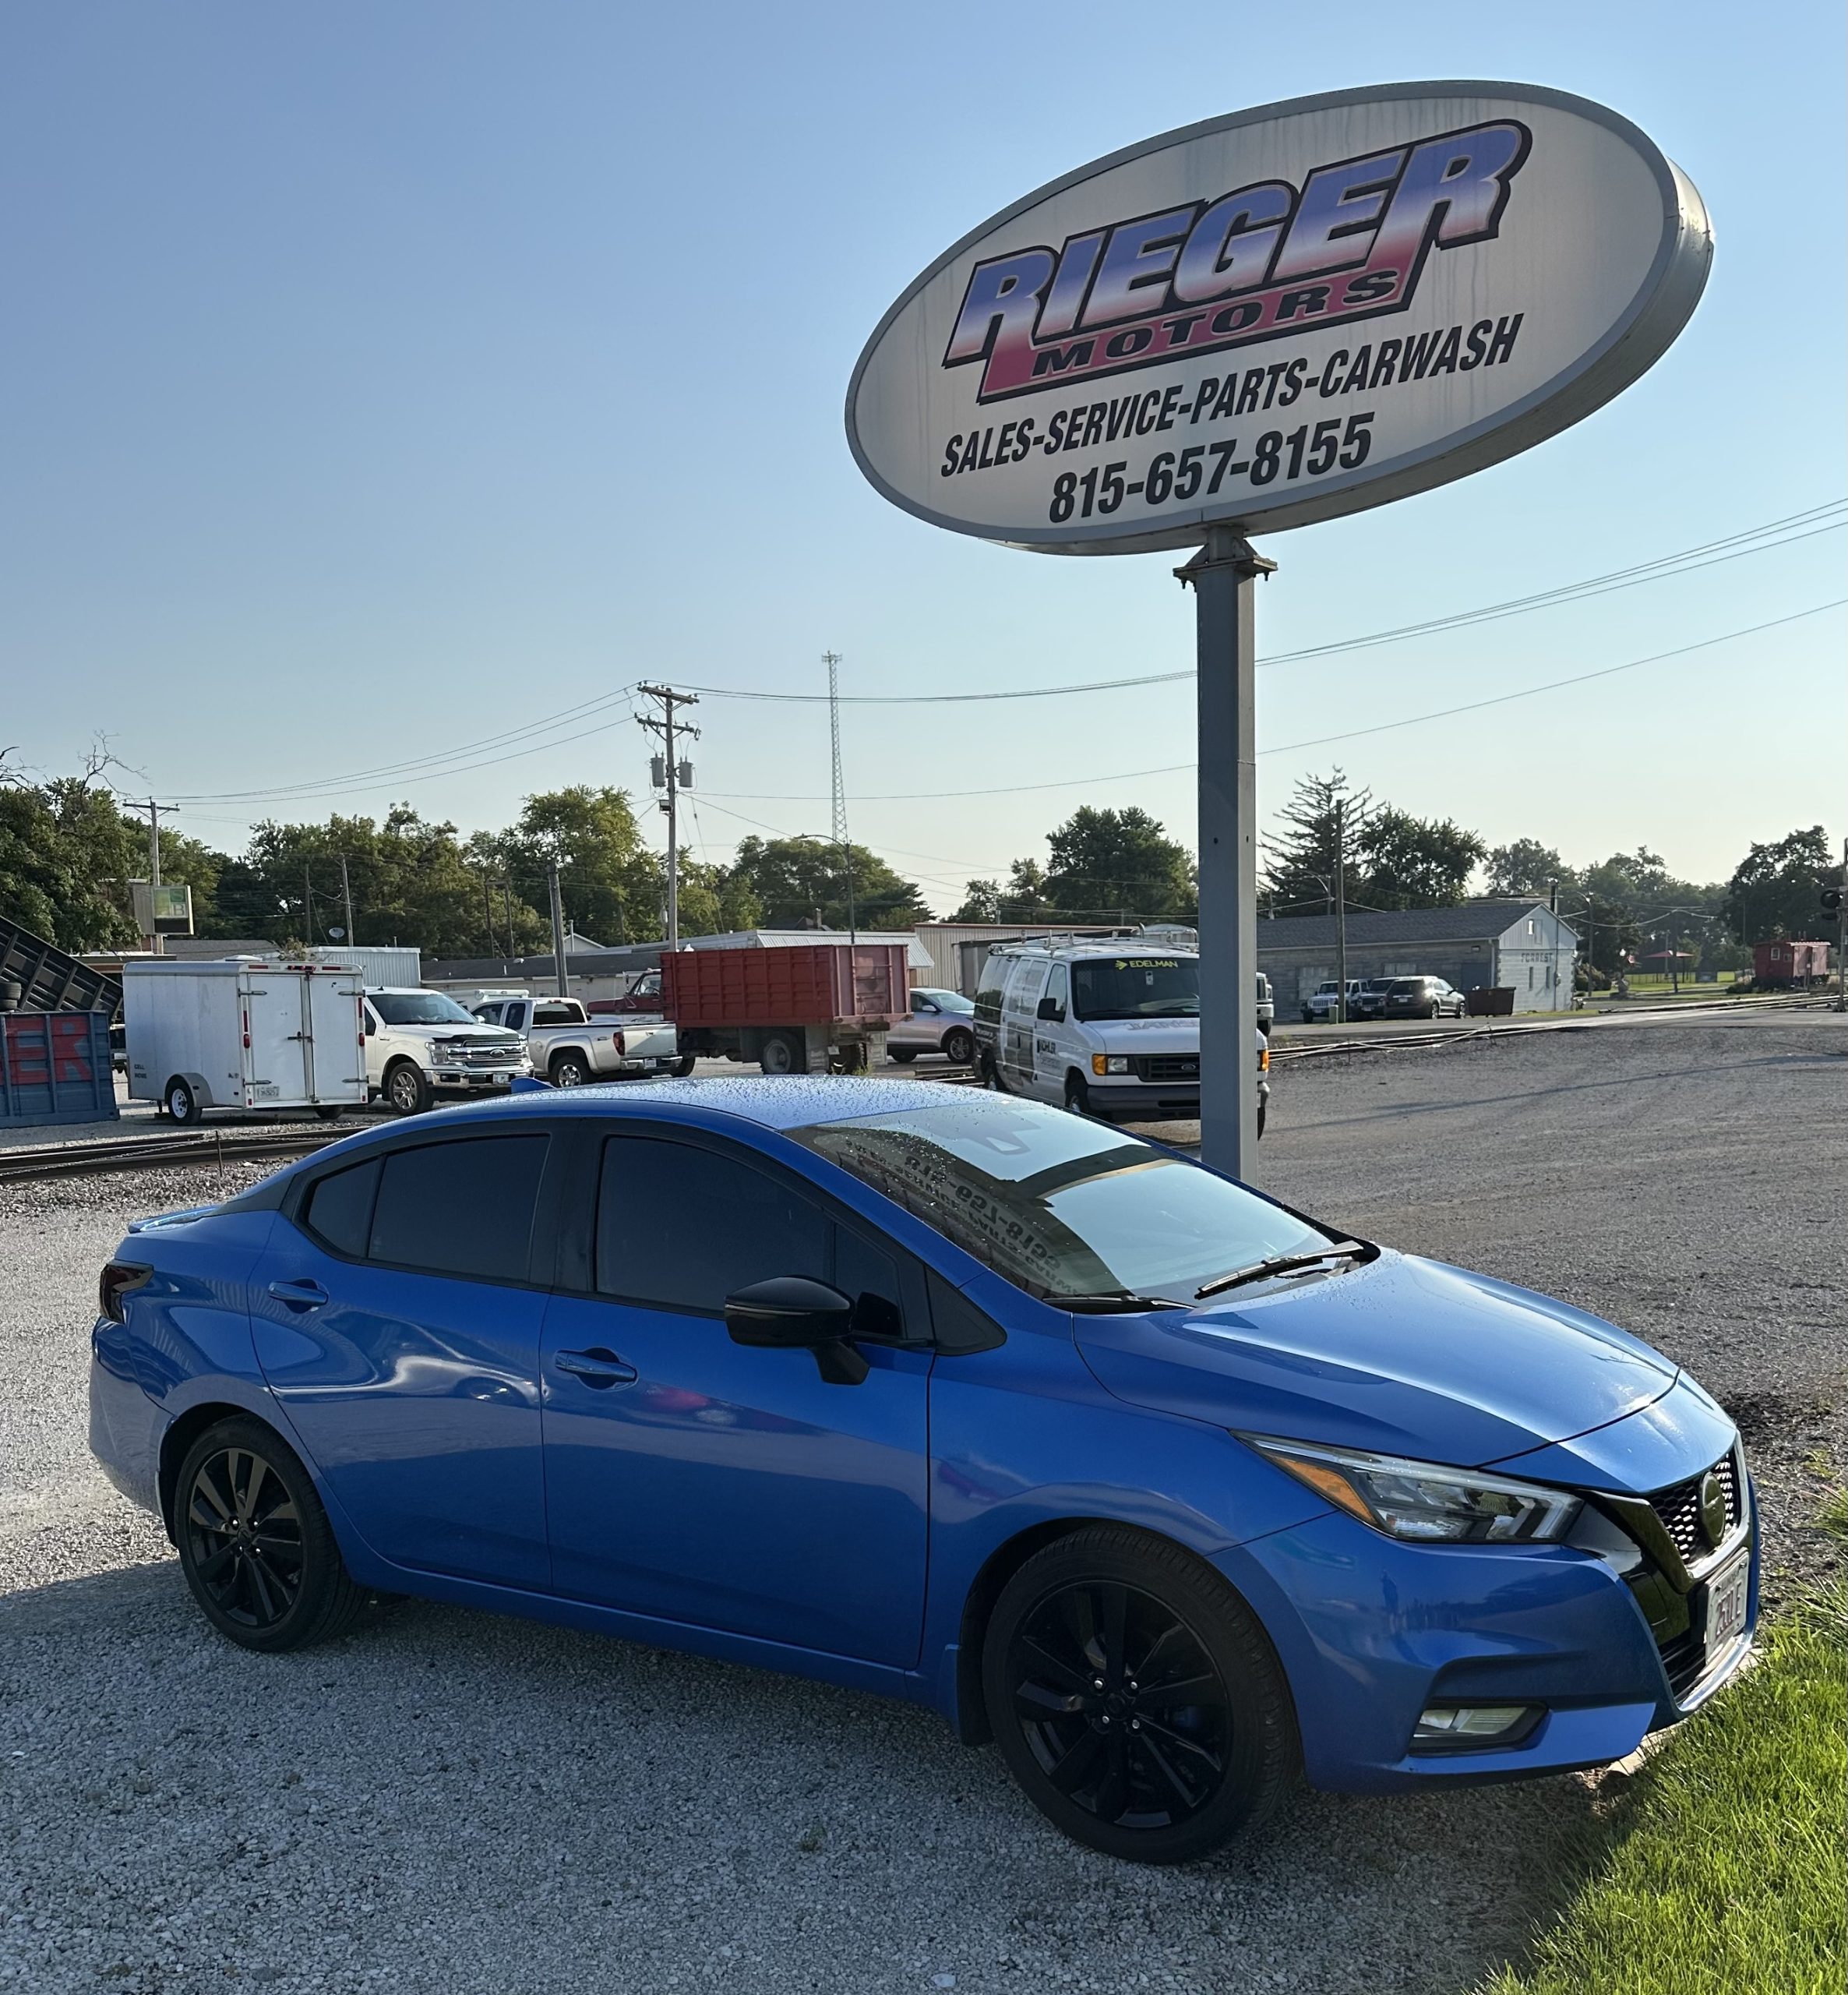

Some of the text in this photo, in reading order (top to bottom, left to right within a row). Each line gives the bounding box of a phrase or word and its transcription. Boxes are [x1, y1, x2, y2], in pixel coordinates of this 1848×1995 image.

[941, 119, 1533, 405] RIEGER
[1031, 270, 1398, 377] MOTORS
[940, 313, 1525, 477] SALES-SERVICE-PARTS-CARWASH
[1049, 411, 1376, 523] 815-657-8155
[1129, 959, 1179, 968] EDELMAN
[1521, 952, 1553, 963] FORREST
